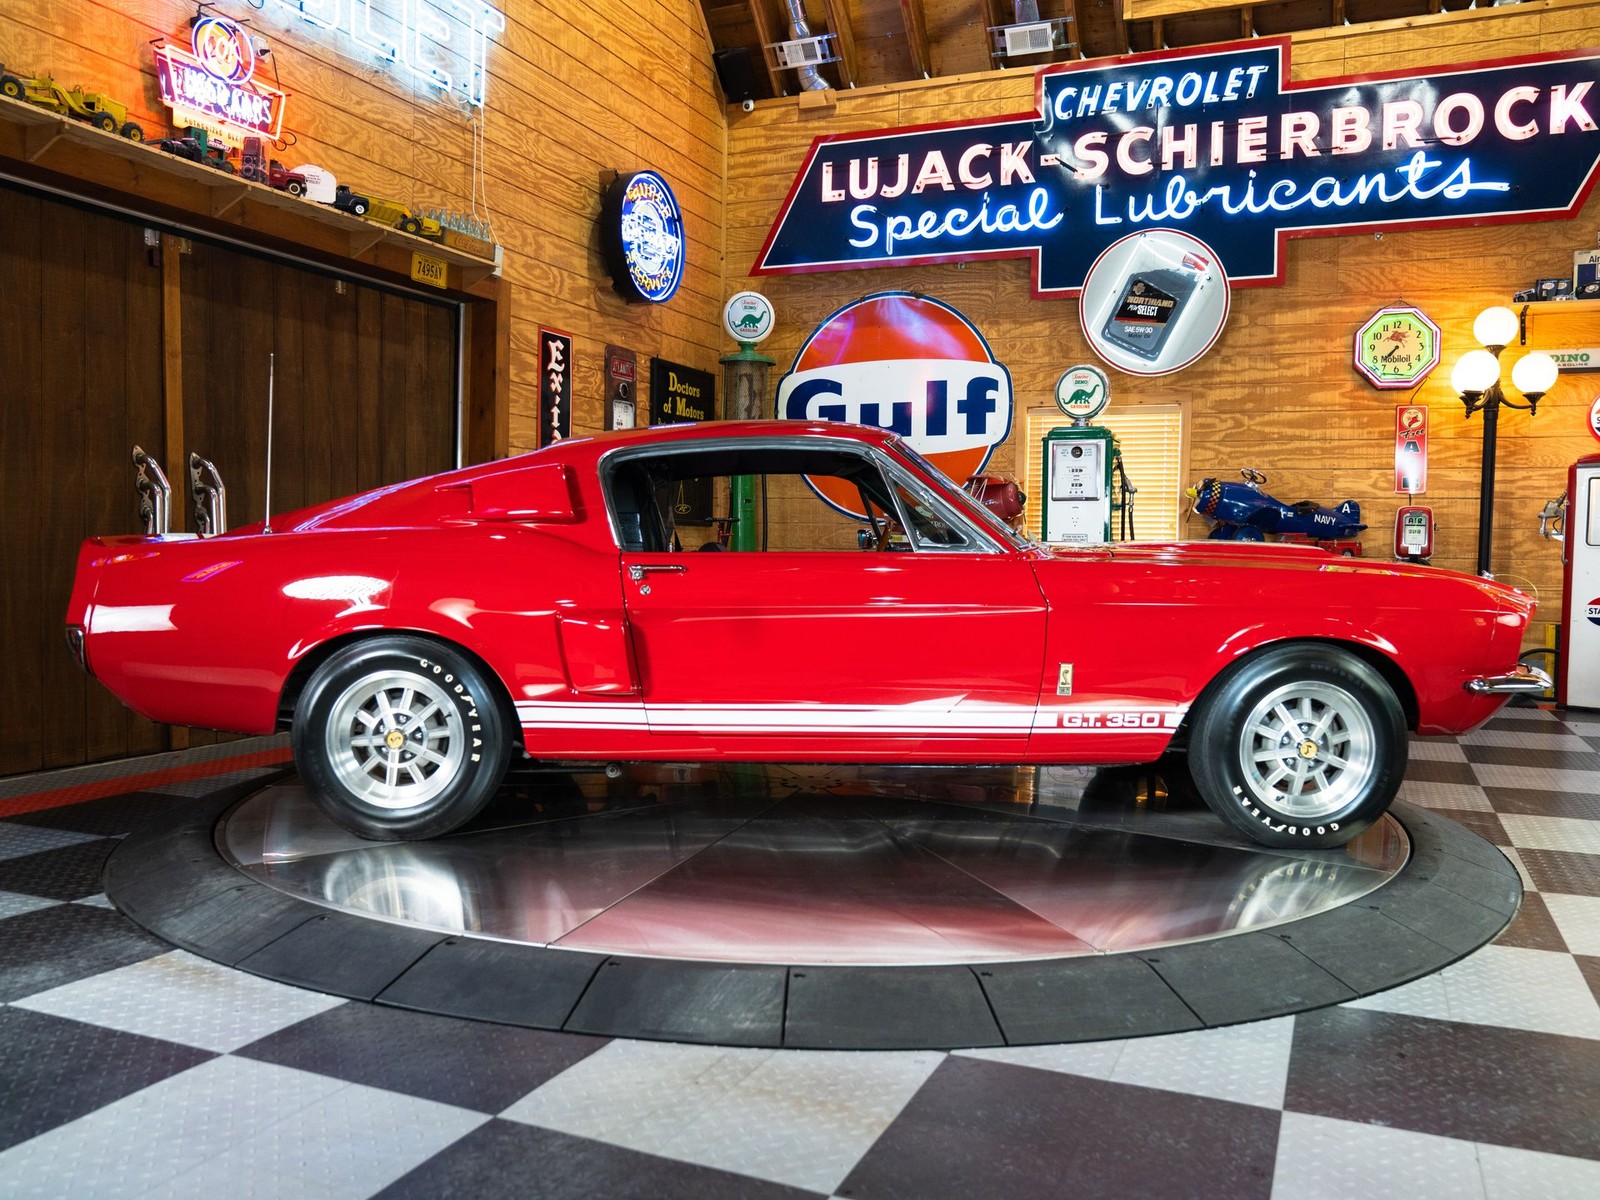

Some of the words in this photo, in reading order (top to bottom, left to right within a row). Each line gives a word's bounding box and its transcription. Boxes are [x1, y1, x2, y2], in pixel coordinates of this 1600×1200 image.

[224, 87, 272, 124] CARS
[1054, 64, 1269, 121] CHEVROLET
[821, 81, 1599, 202] LUJACK-SCHIERBROCK
[848, 187, 1068, 255] Special
[1095, 150, 1511, 228] Lubricants
[1127, 296, 1174, 308] NORTHLAND
[1137, 305, 1158, 316] SELECT
[1550, 353, 1591, 362] DINO
[668, 371, 701, 398] Doctors
[663, 396, 672, 414] of
[676, 396, 705, 421] Motors
[786, 376, 999, 437] Gulf
[1399, 428, 1426, 439] Free
[1314, 514, 1337, 526] NAVY
[1341, 503, 1351, 514] A
[420, 659, 482, 762] GOODYEAR
[1063, 713, 1101, 727] G.T.
[1105, 713, 1160, 727] 350
[1232, 785, 1340, 836] GOODYEAR
